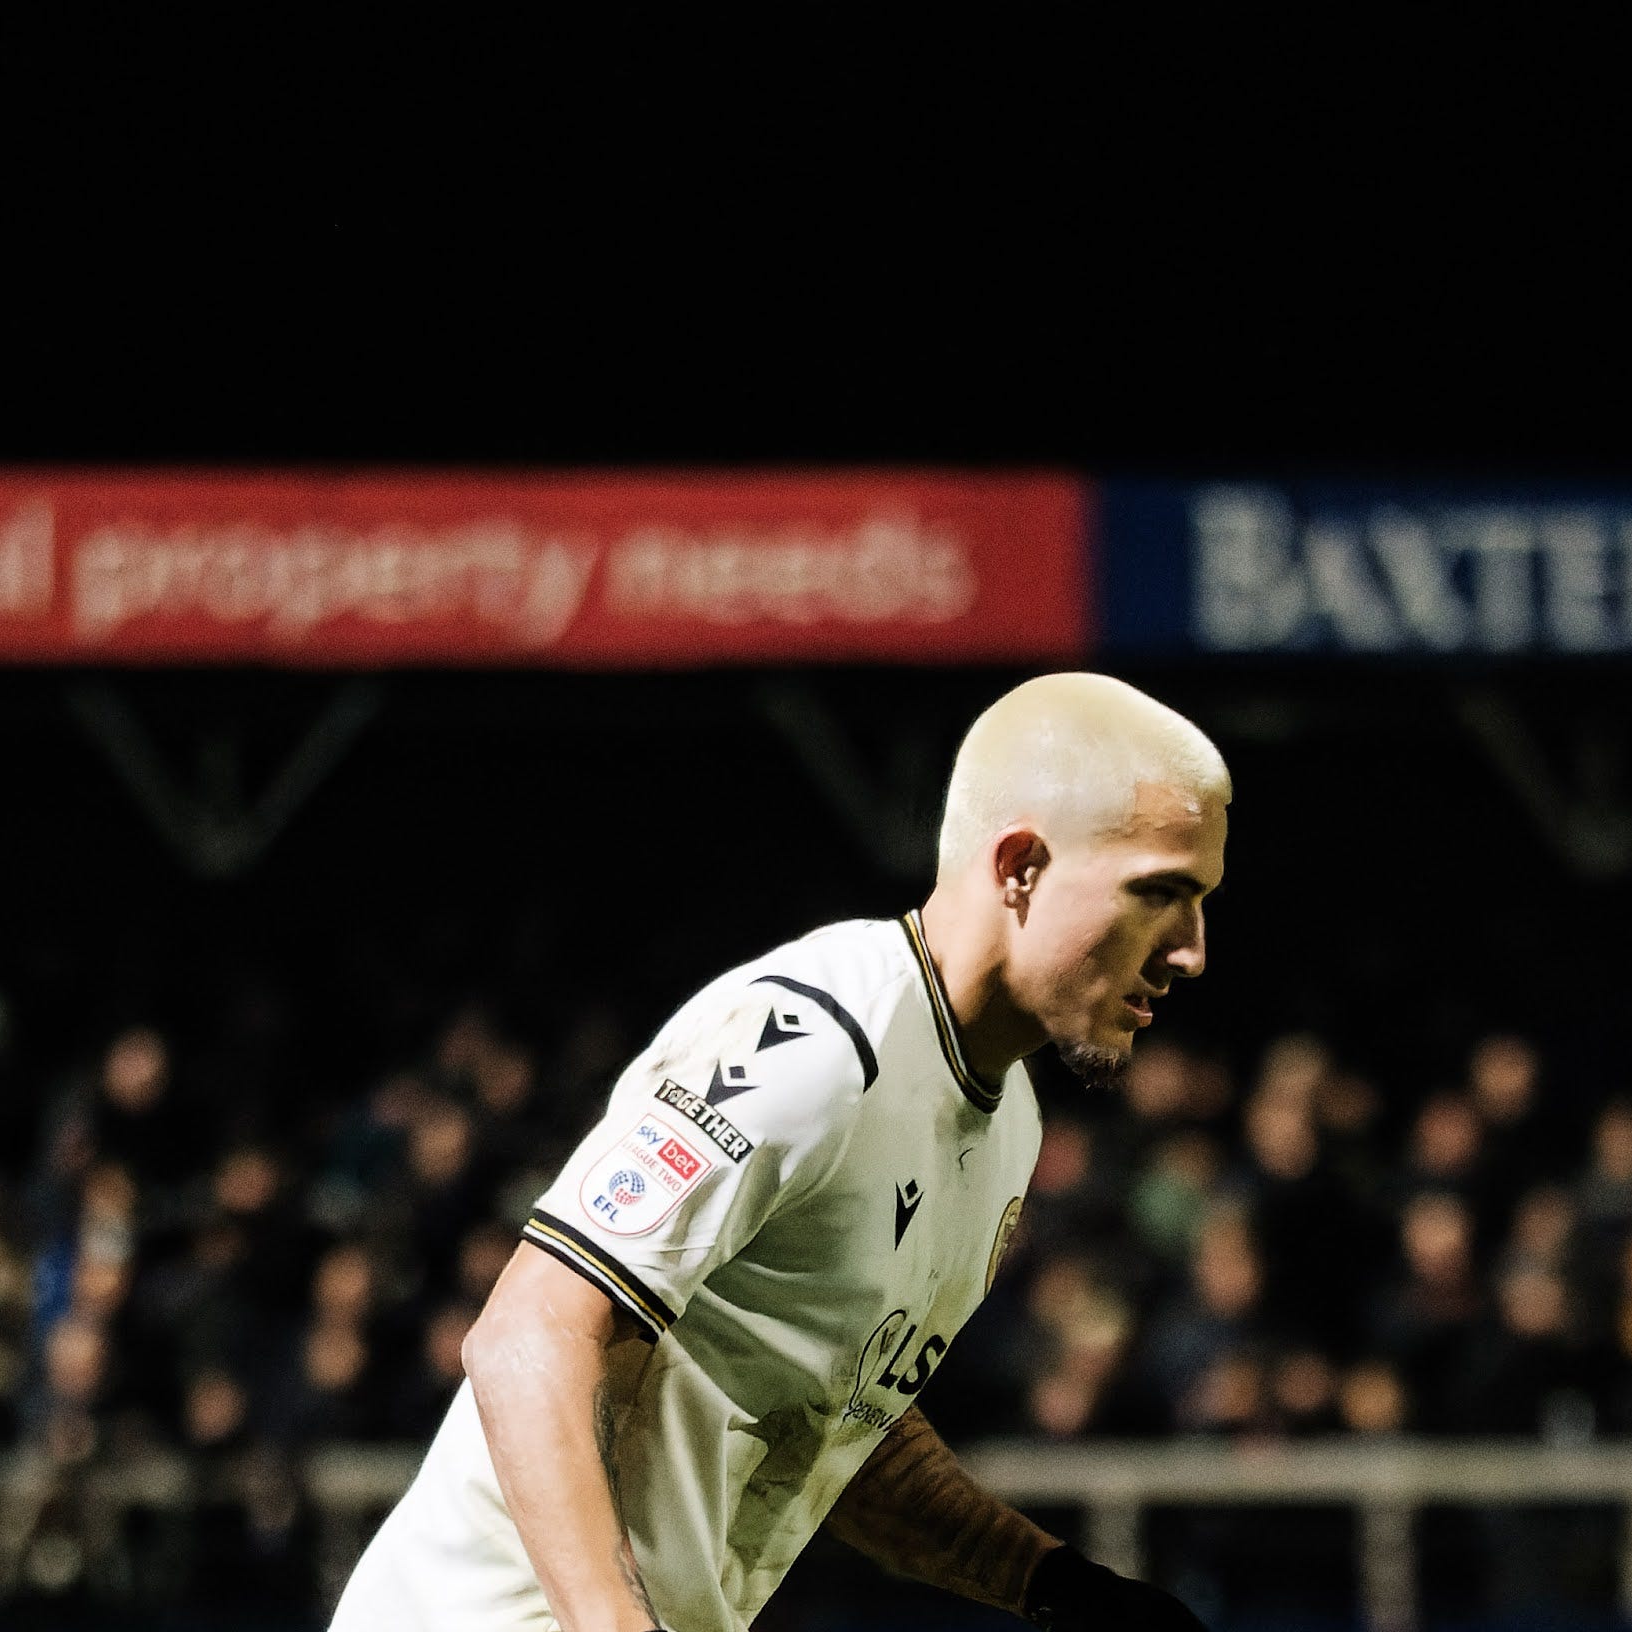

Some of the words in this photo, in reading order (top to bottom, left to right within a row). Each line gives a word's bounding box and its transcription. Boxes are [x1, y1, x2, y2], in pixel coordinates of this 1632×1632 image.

[71, 518, 601, 650] property
[609, 501, 973, 624] needs
[659, 1081, 748, 1159] TOGETHER
[636, 1125, 665, 1146] sky
[662, 1141, 697, 1175] bet
[658, 1168, 684, 1192] TWO
[593, 1195, 621, 1223] EFL
